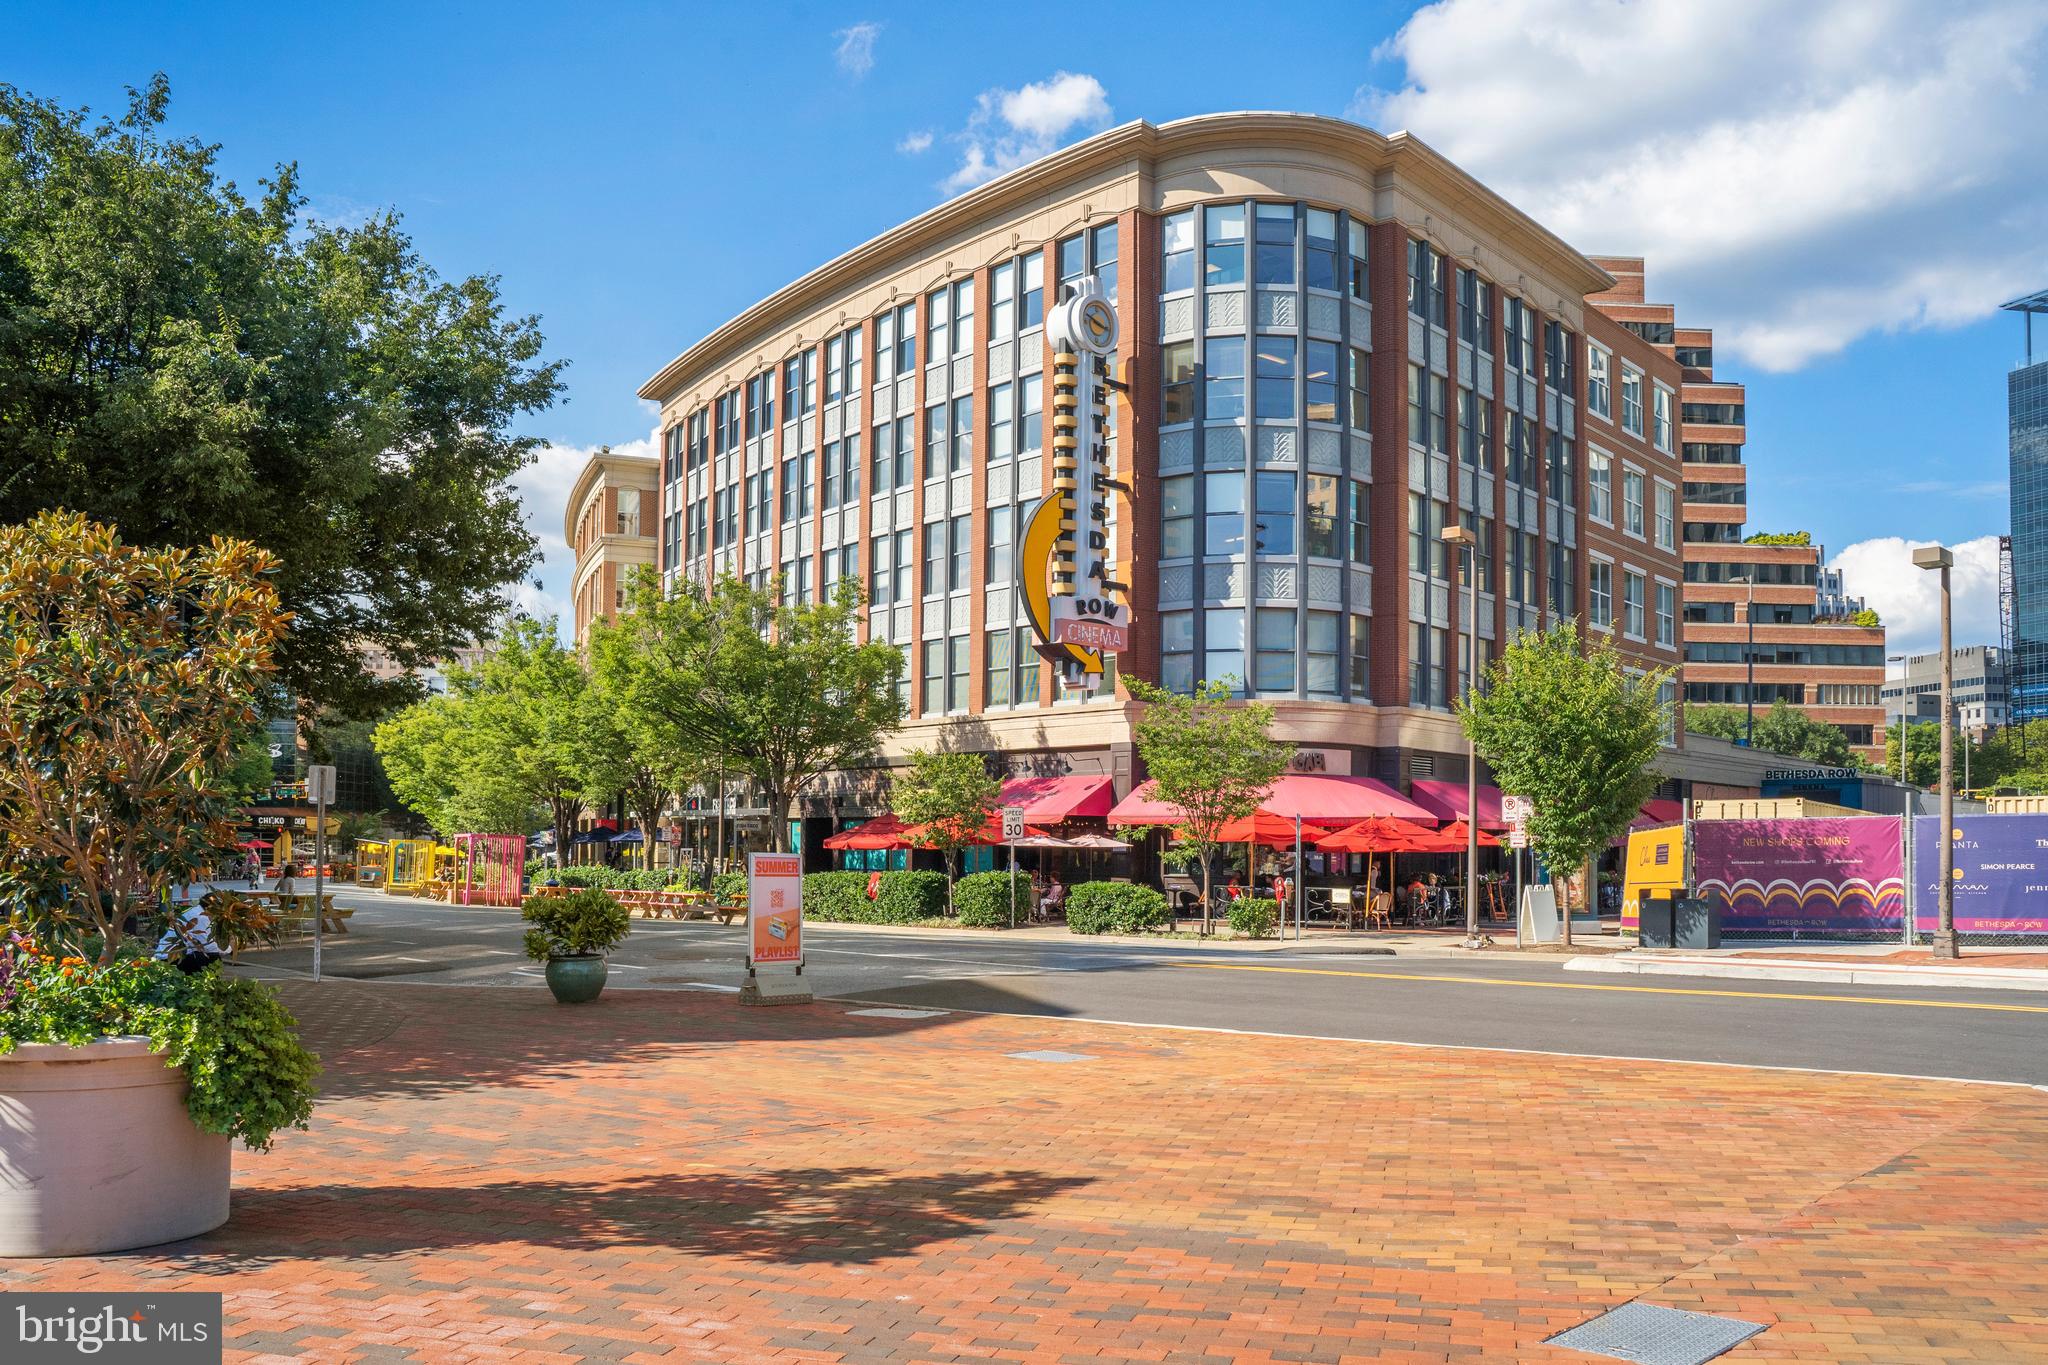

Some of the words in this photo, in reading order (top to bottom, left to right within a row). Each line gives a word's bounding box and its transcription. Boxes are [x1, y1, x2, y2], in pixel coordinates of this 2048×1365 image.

[1089, 356, 1107, 581] BETHESDA
[1075, 599, 1119, 620] ROW
[1067, 623, 1122, 646] CINEMA
[1766, 769, 1823, 780] BETHESDA
[1829, 769, 1858, 779] ROW
[1006, 824, 1021, 835] 30
[1744, 838, 1764, 847] NEW
[1768, 837, 1803, 847] SHOPS
[1806, 836, 1850, 846] COMING
[1936, 841, 1979, 849] PANTA
[755, 861, 798, 873] SUMMER
[754, 946, 799, 958] PLAYLIST
